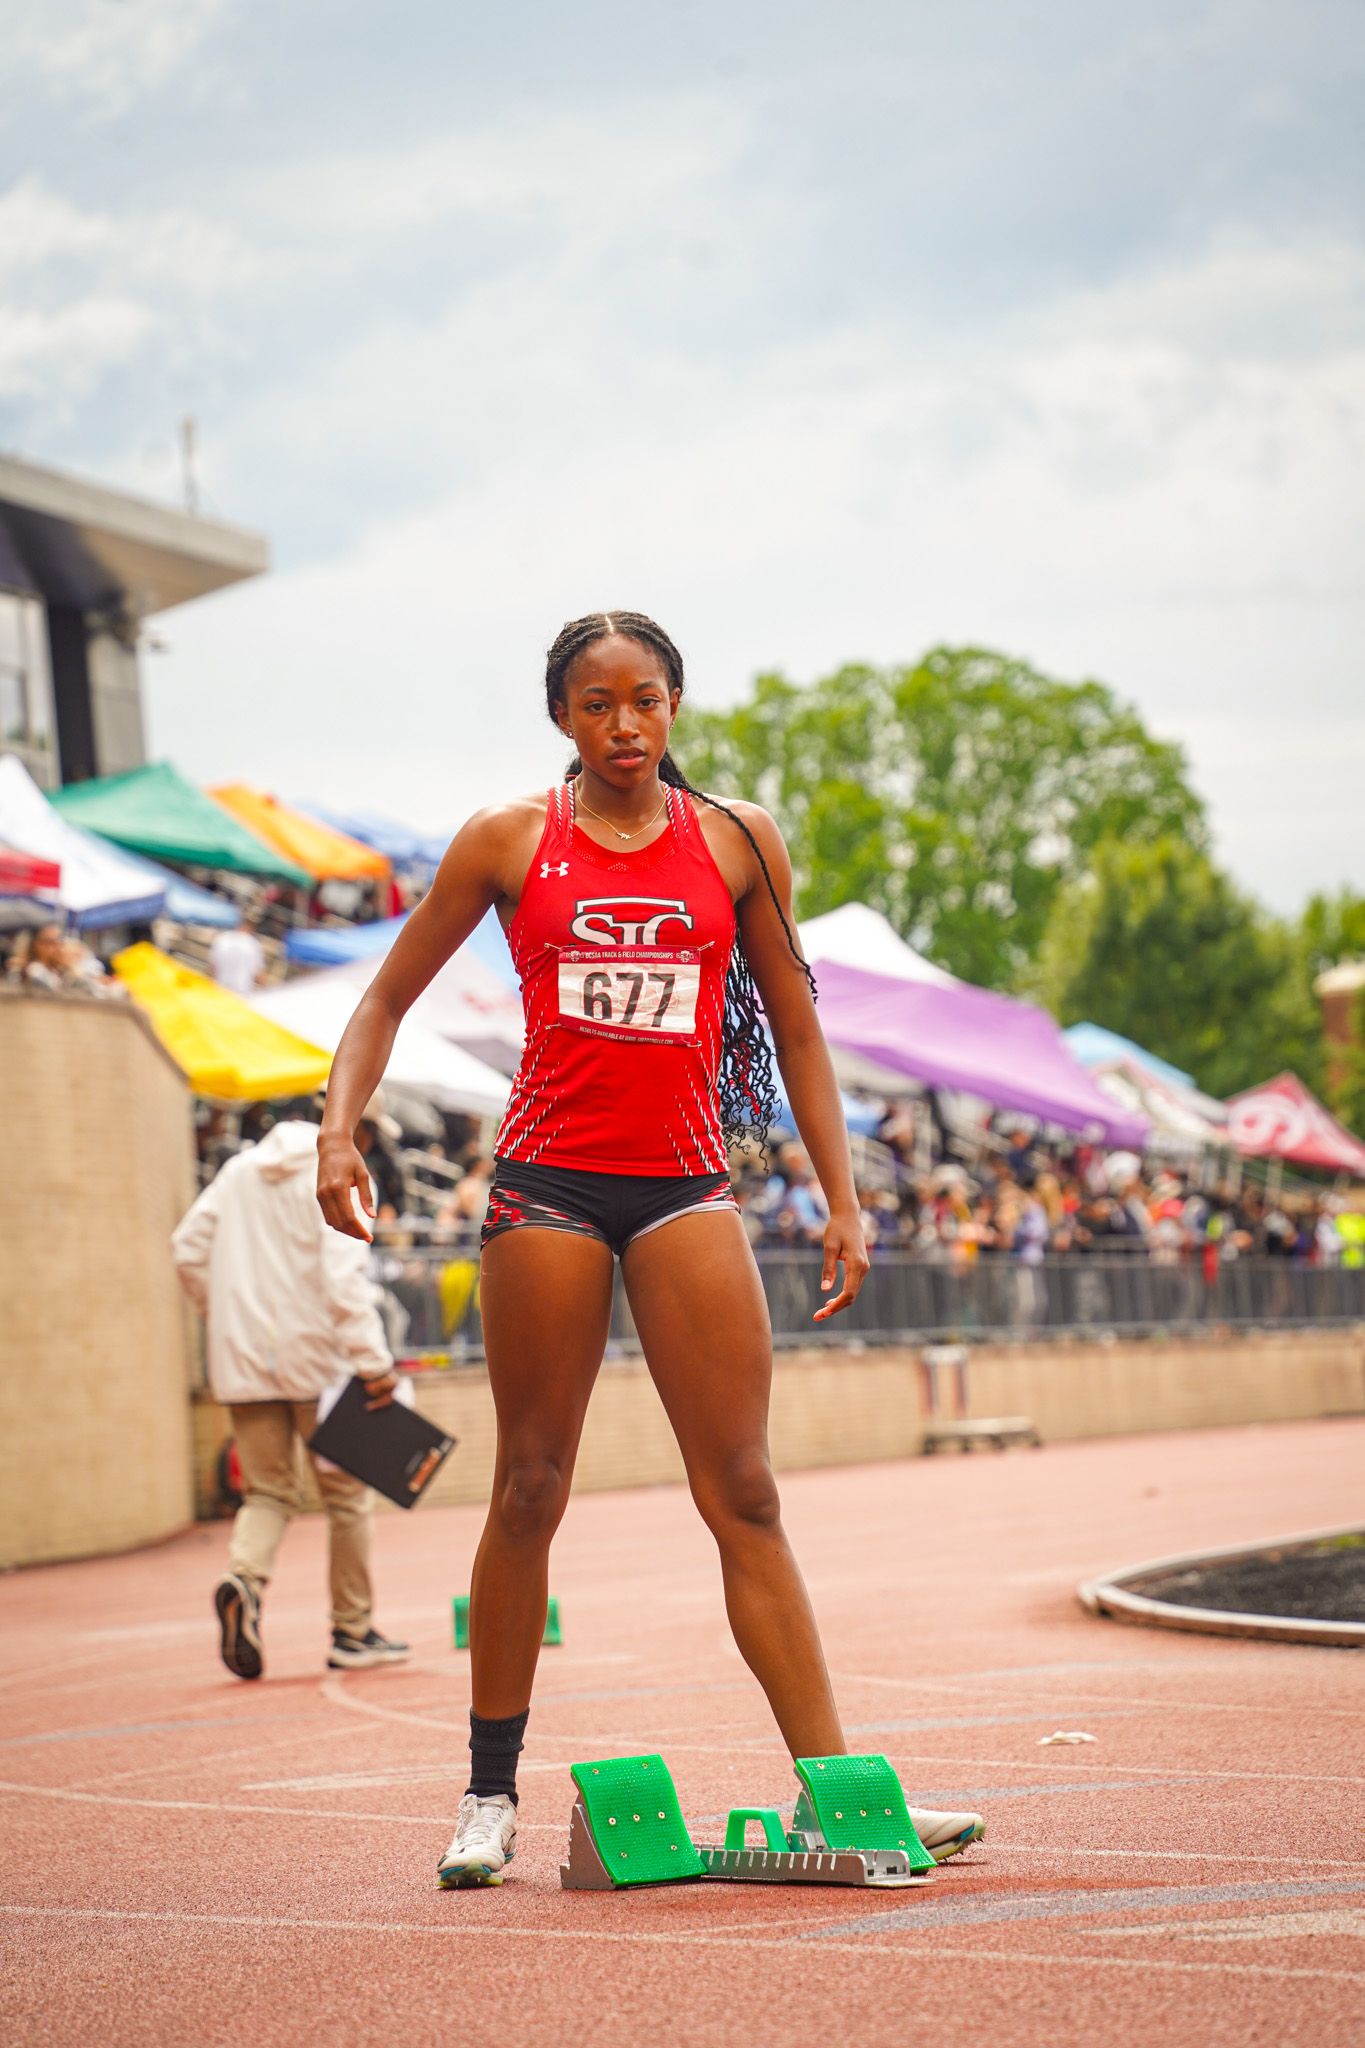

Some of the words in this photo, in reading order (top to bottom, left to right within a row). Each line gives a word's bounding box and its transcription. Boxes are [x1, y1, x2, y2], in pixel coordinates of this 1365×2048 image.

[602, 951, 617, 959] TRACK
[622, 951, 635, 959] FIELD
[635, 951, 674, 960] CHAMPIONSHIPS
[583, 971, 676, 1027] 677
